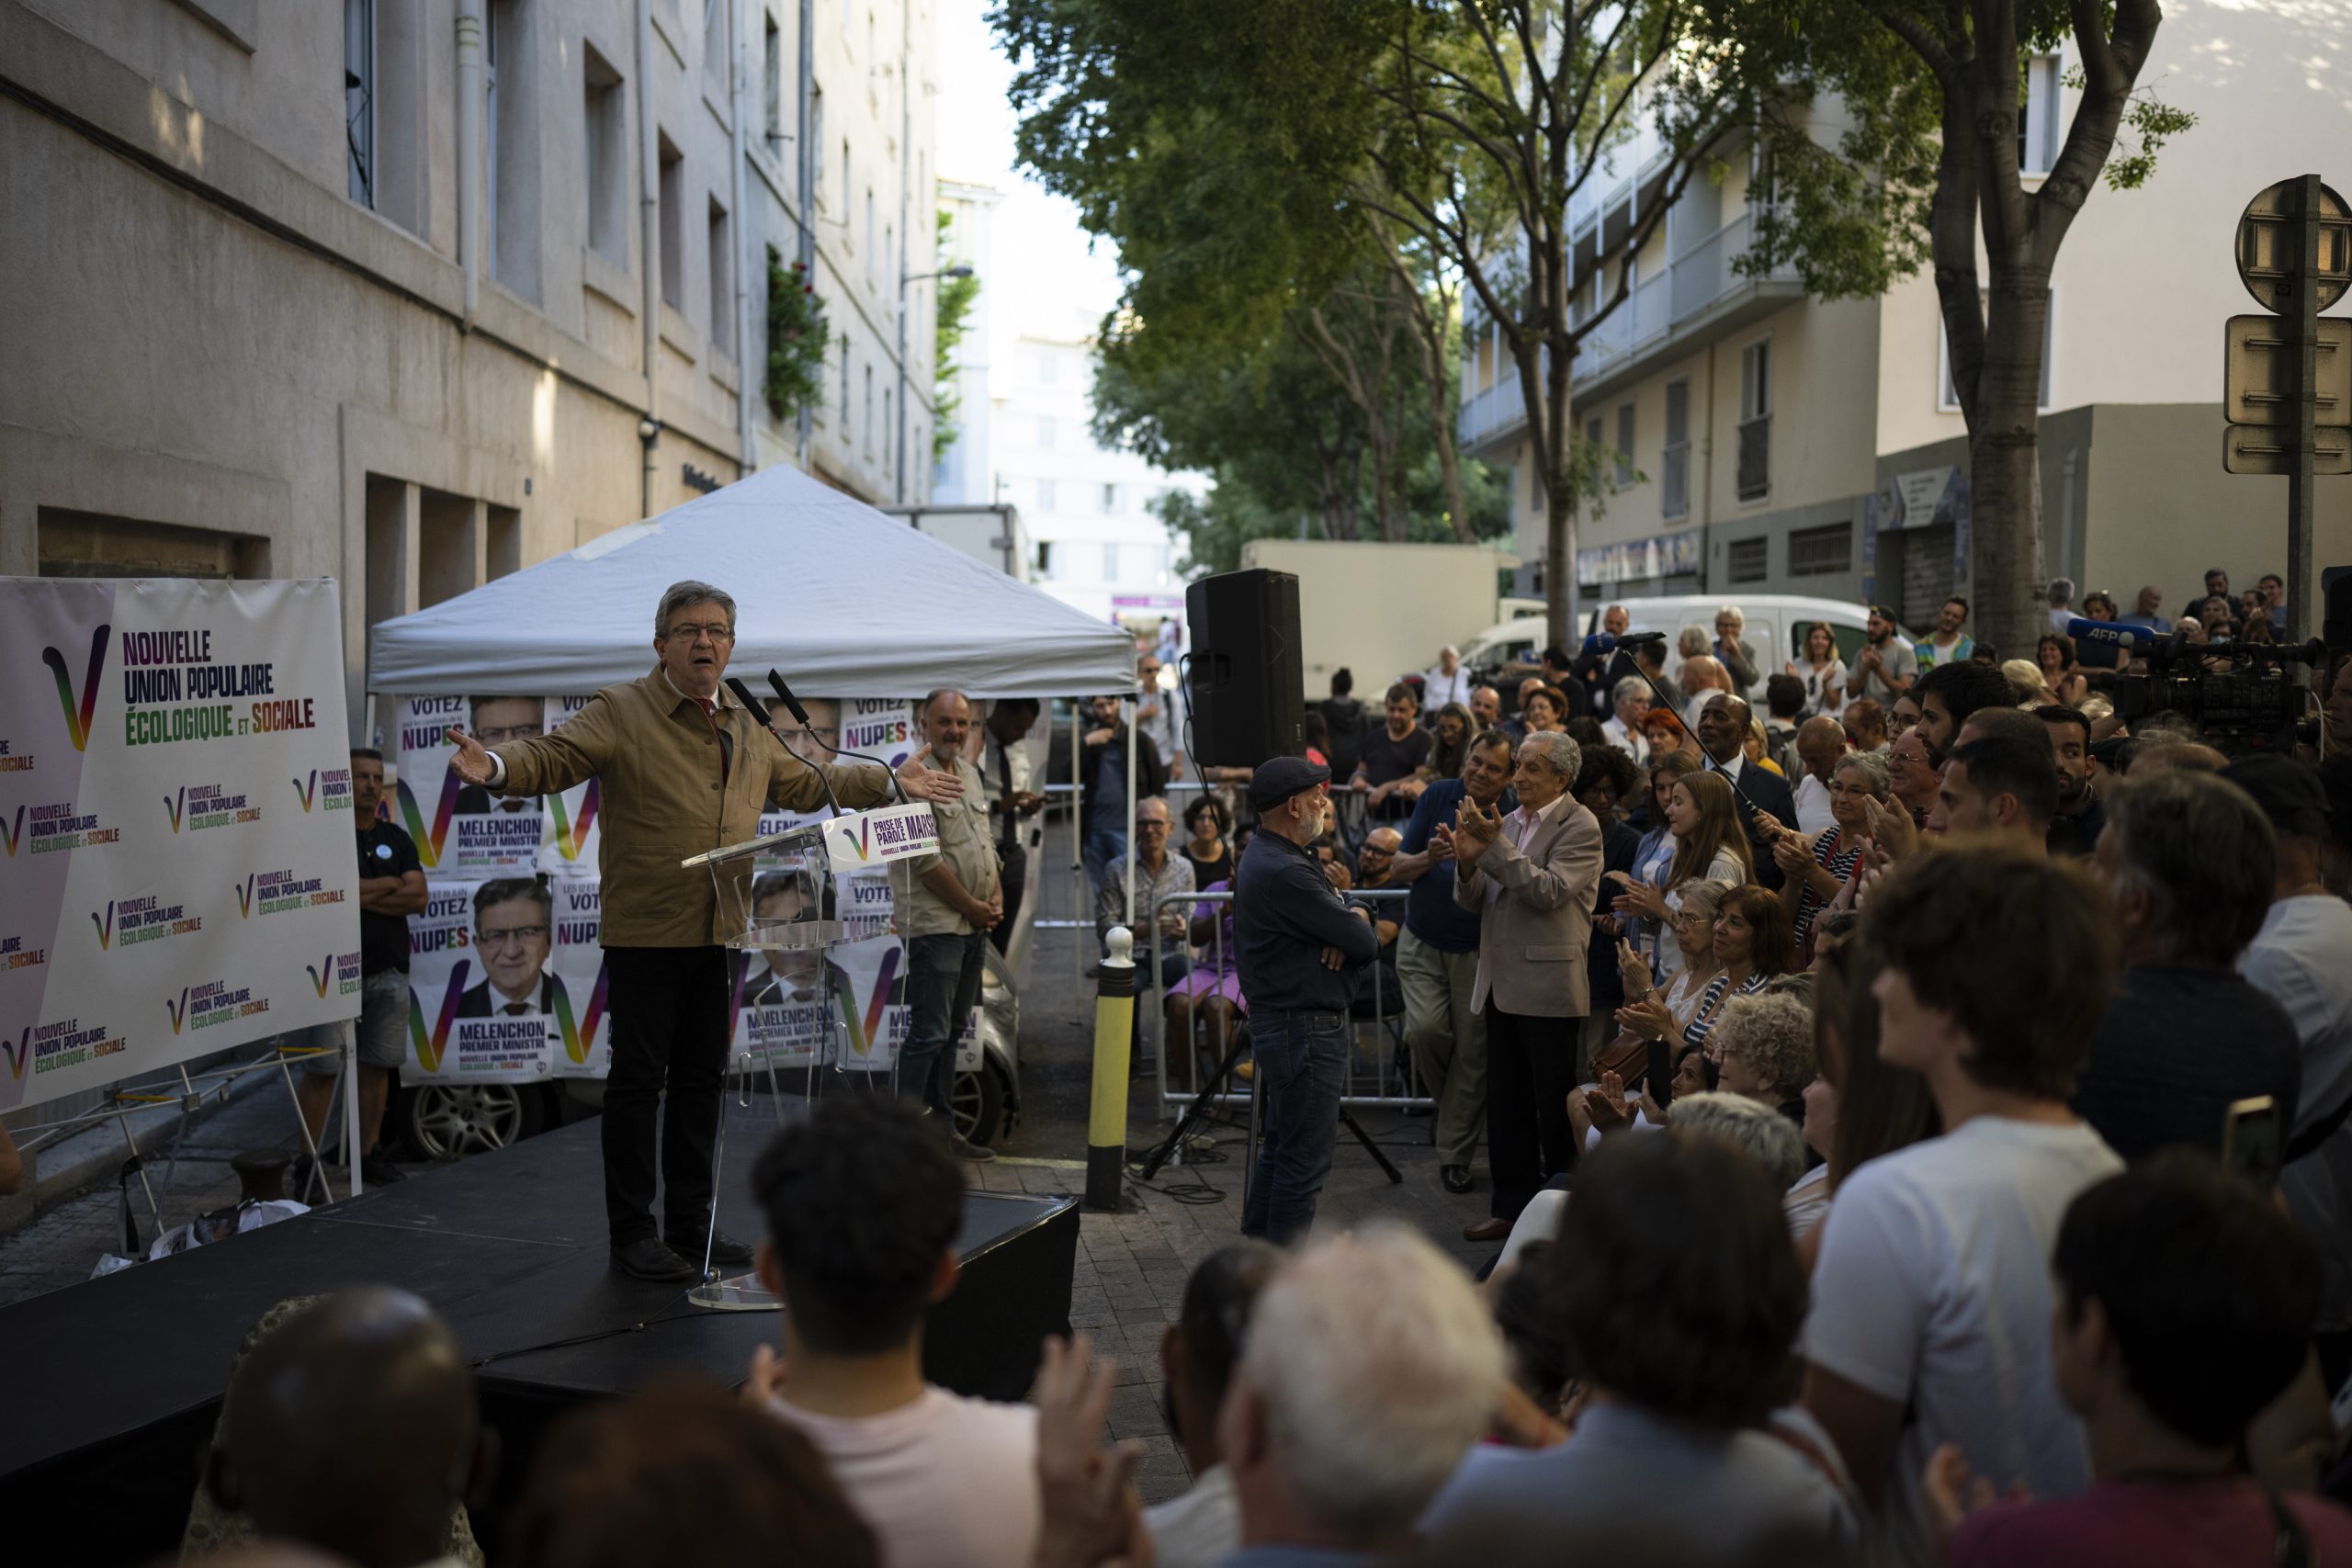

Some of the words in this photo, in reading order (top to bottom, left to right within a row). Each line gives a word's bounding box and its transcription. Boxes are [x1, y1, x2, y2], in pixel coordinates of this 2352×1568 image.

[2087, 627, 2119, 642] AFP
[122, 630, 211, 666] NOUVELLE
[124, 669, 181, 704] UNION
[187, 663, 274, 700] POPULAIRE
[412, 694, 463, 715] VOTEZ
[855, 698, 906, 715] VOTEZ
[125, 705, 233, 746] ÉCOLOGIQUE
[238, 718, 249, 735] ET
[252, 698, 315, 733] SOCIALE
[847, 721, 907, 750] NUPES
[322, 769, 350, 784] NOUVEL
[188, 784, 220, 801] NOUVELLE
[322, 783, 345, 795] UNION
[30, 803, 71, 821] NOUVELLE
[189, 801, 209, 815] UNION
[210, 795, 246, 812] POPULAIRE
[323, 795, 352, 811] ÉCOLOG
[30, 821, 57, 837] UNION
[60, 815, 97, 833] POPULAIRE
[190, 813, 229, 830] ÉCOLOGIQUE
[237, 808, 261, 823] SOCIALE
[874, 819, 895, 833] PRISE
[894, 818, 903, 829] DE
[30, 834, 80, 854] ÉCOLOGIQUE
[87, 829, 119, 845] SOCIALE
[458, 837, 497, 848] PREMIER
[500, 835, 541, 846] MINISTRE
[876, 829, 907, 846] PAROLE
[257, 870, 292, 886] NOUVELLE
[258, 885, 279, 900] UNION
[282, 879, 322, 896] POPULAIRE
[854, 886, 891, 903] VOTE
[118, 897, 156, 915] NOUVELLE
[259, 897, 302, 915] ÉCOLOGIQUE
[311, 890, 345, 906] SOCIALE
[420, 897, 467, 919] OTEZ
[571, 894, 598, 909] VOT
[119, 914, 141, 930] UNION
[144, 906, 183, 925] POPULAIRE
[119, 925, 164, 946] ÉCOLOGIQUE
[173, 918, 201, 935] SOCIALE
[409, 925, 469, 954] NUPES
[559, 922, 602, 944] NUP
[8, 950, 44, 969] SOCIALE
[337, 952, 360, 966] NOUVE
[338, 965, 359, 980] UNION
[191, 981, 224, 1000] NOUVELLE
[191, 999, 211, 1014] UNION
[214, 988, 250, 1009] POPULAIRE
[191, 1009, 233, 1030] ÉCOLOGIQUE
[241, 998, 269, 1017] SOCIALE
[35, 1019, 77, 1042] NOUVELLE
[35, 1041, 61, 1056] UNION
[64, 1027, 106, 1049] POPULAIRE
[459, 1041, 500, 1053] PREMIER
[503, 1038, 546, 1051] MINISTRE
[35, 1050, 85, 1074] ÉCOLOGIQUE
[94, 1038, 126, 1058] SOCIALE
